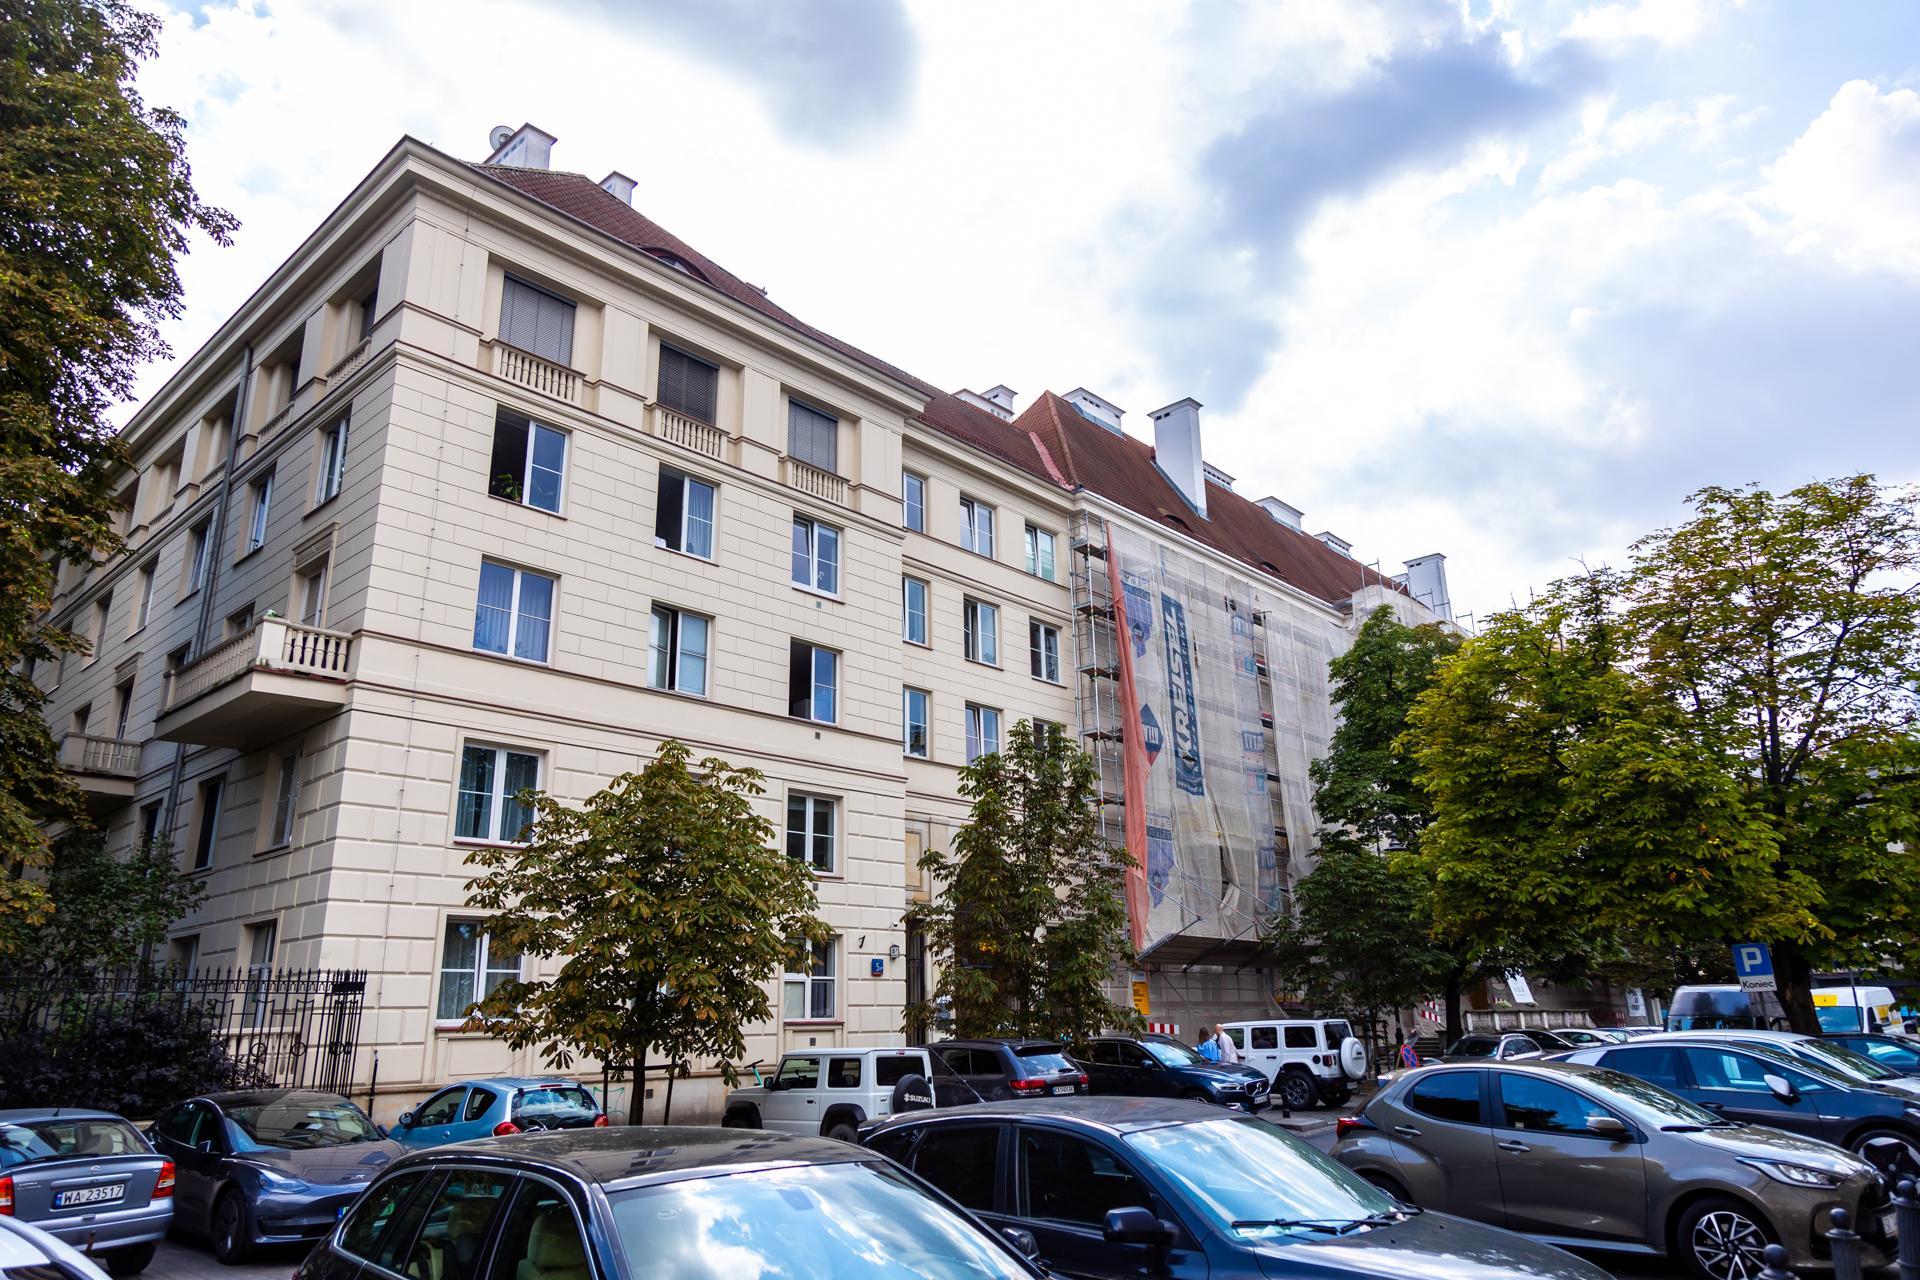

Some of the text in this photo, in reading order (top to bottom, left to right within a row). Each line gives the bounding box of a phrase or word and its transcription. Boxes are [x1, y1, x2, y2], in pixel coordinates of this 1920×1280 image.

[1165, 606, 1192, 751] KREISEL
[1740, 947, 1763, 973] P
[1742, 980, 1774, 989] Koniec
[910, 1095, 931, 1104] SUZUKI
[64, 1185, 123, 1205] WA 23517
